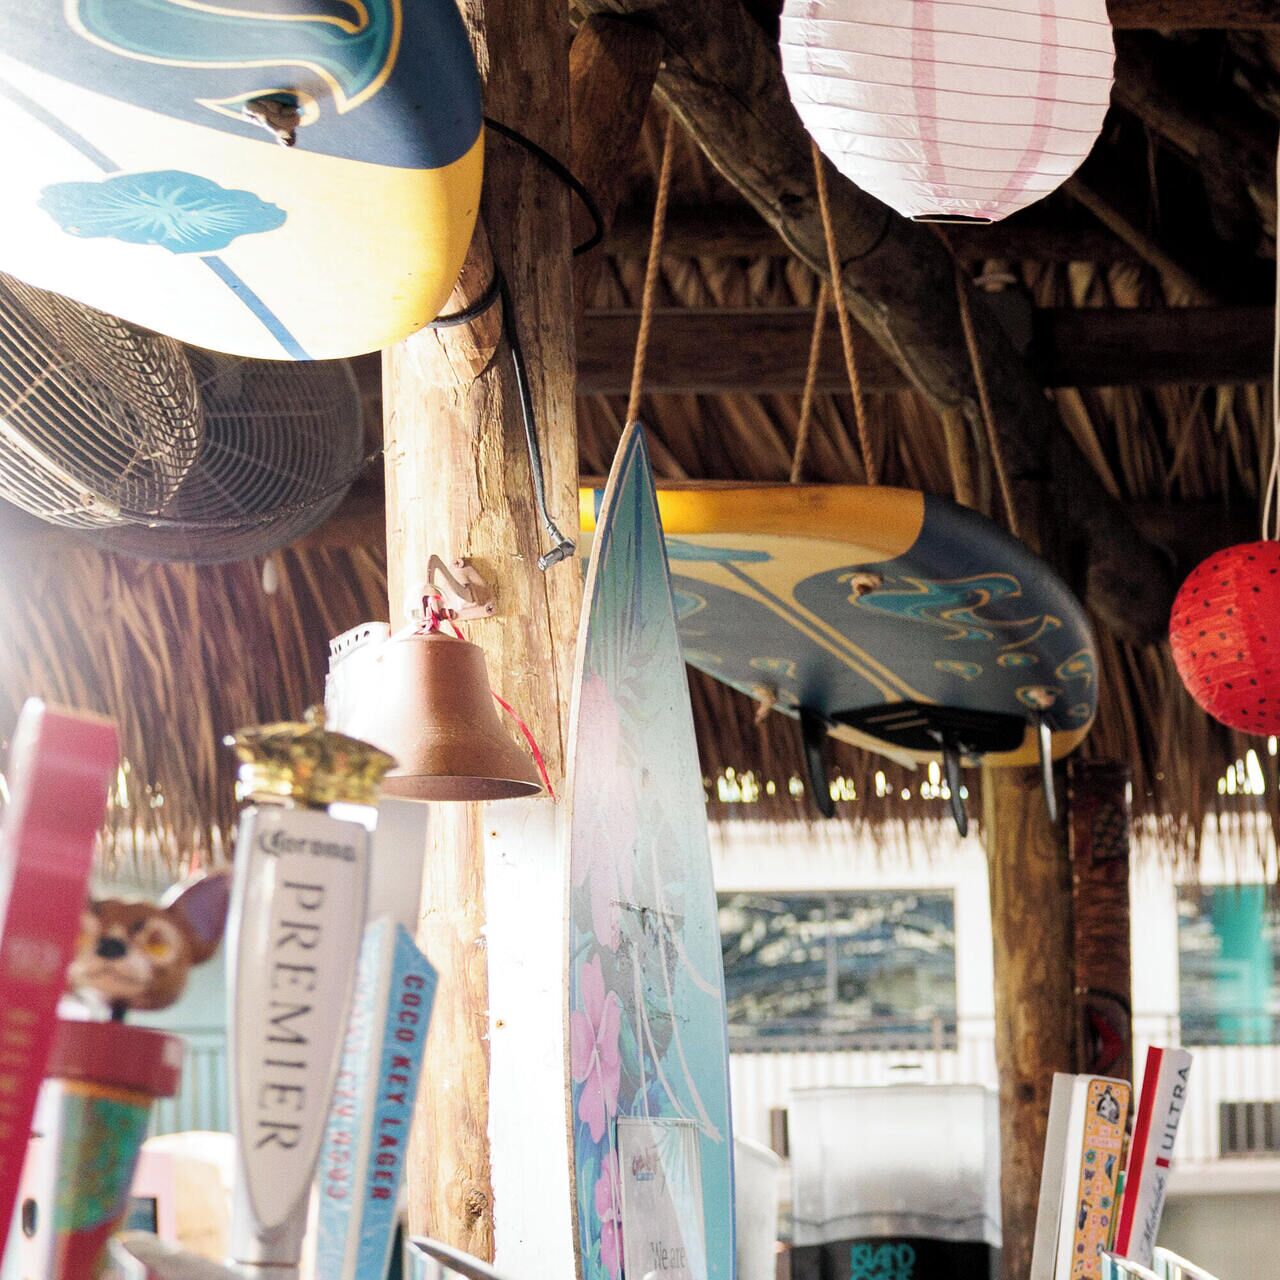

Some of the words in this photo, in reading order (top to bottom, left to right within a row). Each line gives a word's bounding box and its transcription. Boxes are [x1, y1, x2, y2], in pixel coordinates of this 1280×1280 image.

[258, 829, 357, 863] Corona
[253, 879, 325, 1152] PREMIER
[395, 974, 425, 1043] COCO
[386, 1057, 413, 1106] KEY
[1161, 1066, 1190, 1151] ULTRA
[370, 1117, 402, 1201] LAGER
[650, 1240, 669, 1271] We
[670, 1247, 686, 1269] are
